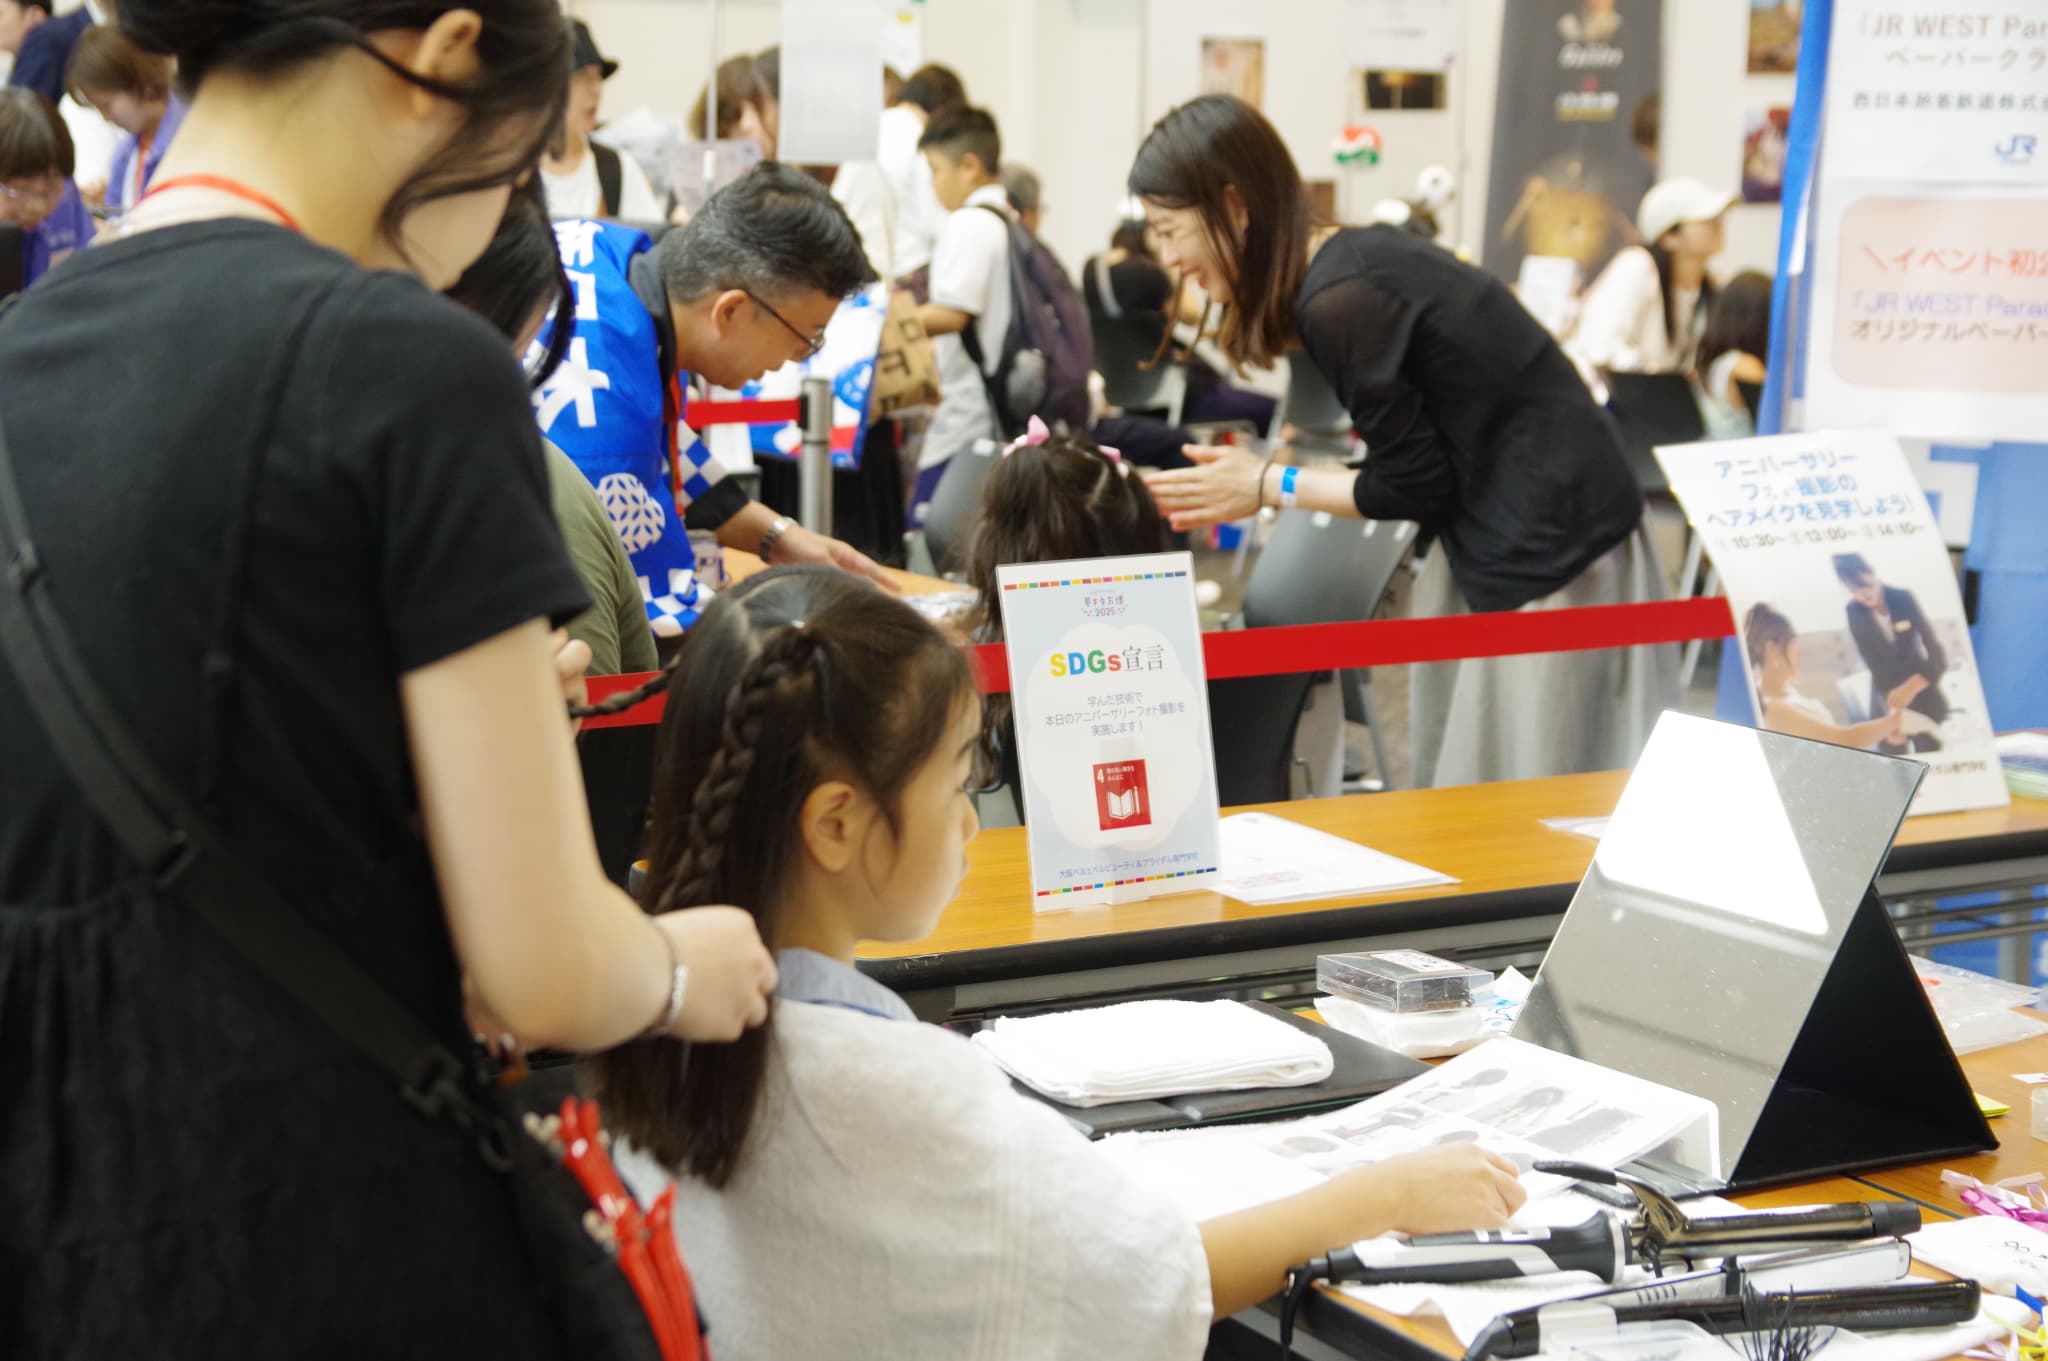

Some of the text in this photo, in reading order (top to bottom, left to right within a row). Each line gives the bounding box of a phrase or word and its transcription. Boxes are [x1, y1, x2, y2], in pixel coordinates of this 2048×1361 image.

[1914, 13, 1993, 38] WEST
[1906, 293, 1977, 314] WEST
[1050, 644, 1164, 677] SDGs宣言
[1097, 768, 1105, 783] 4
